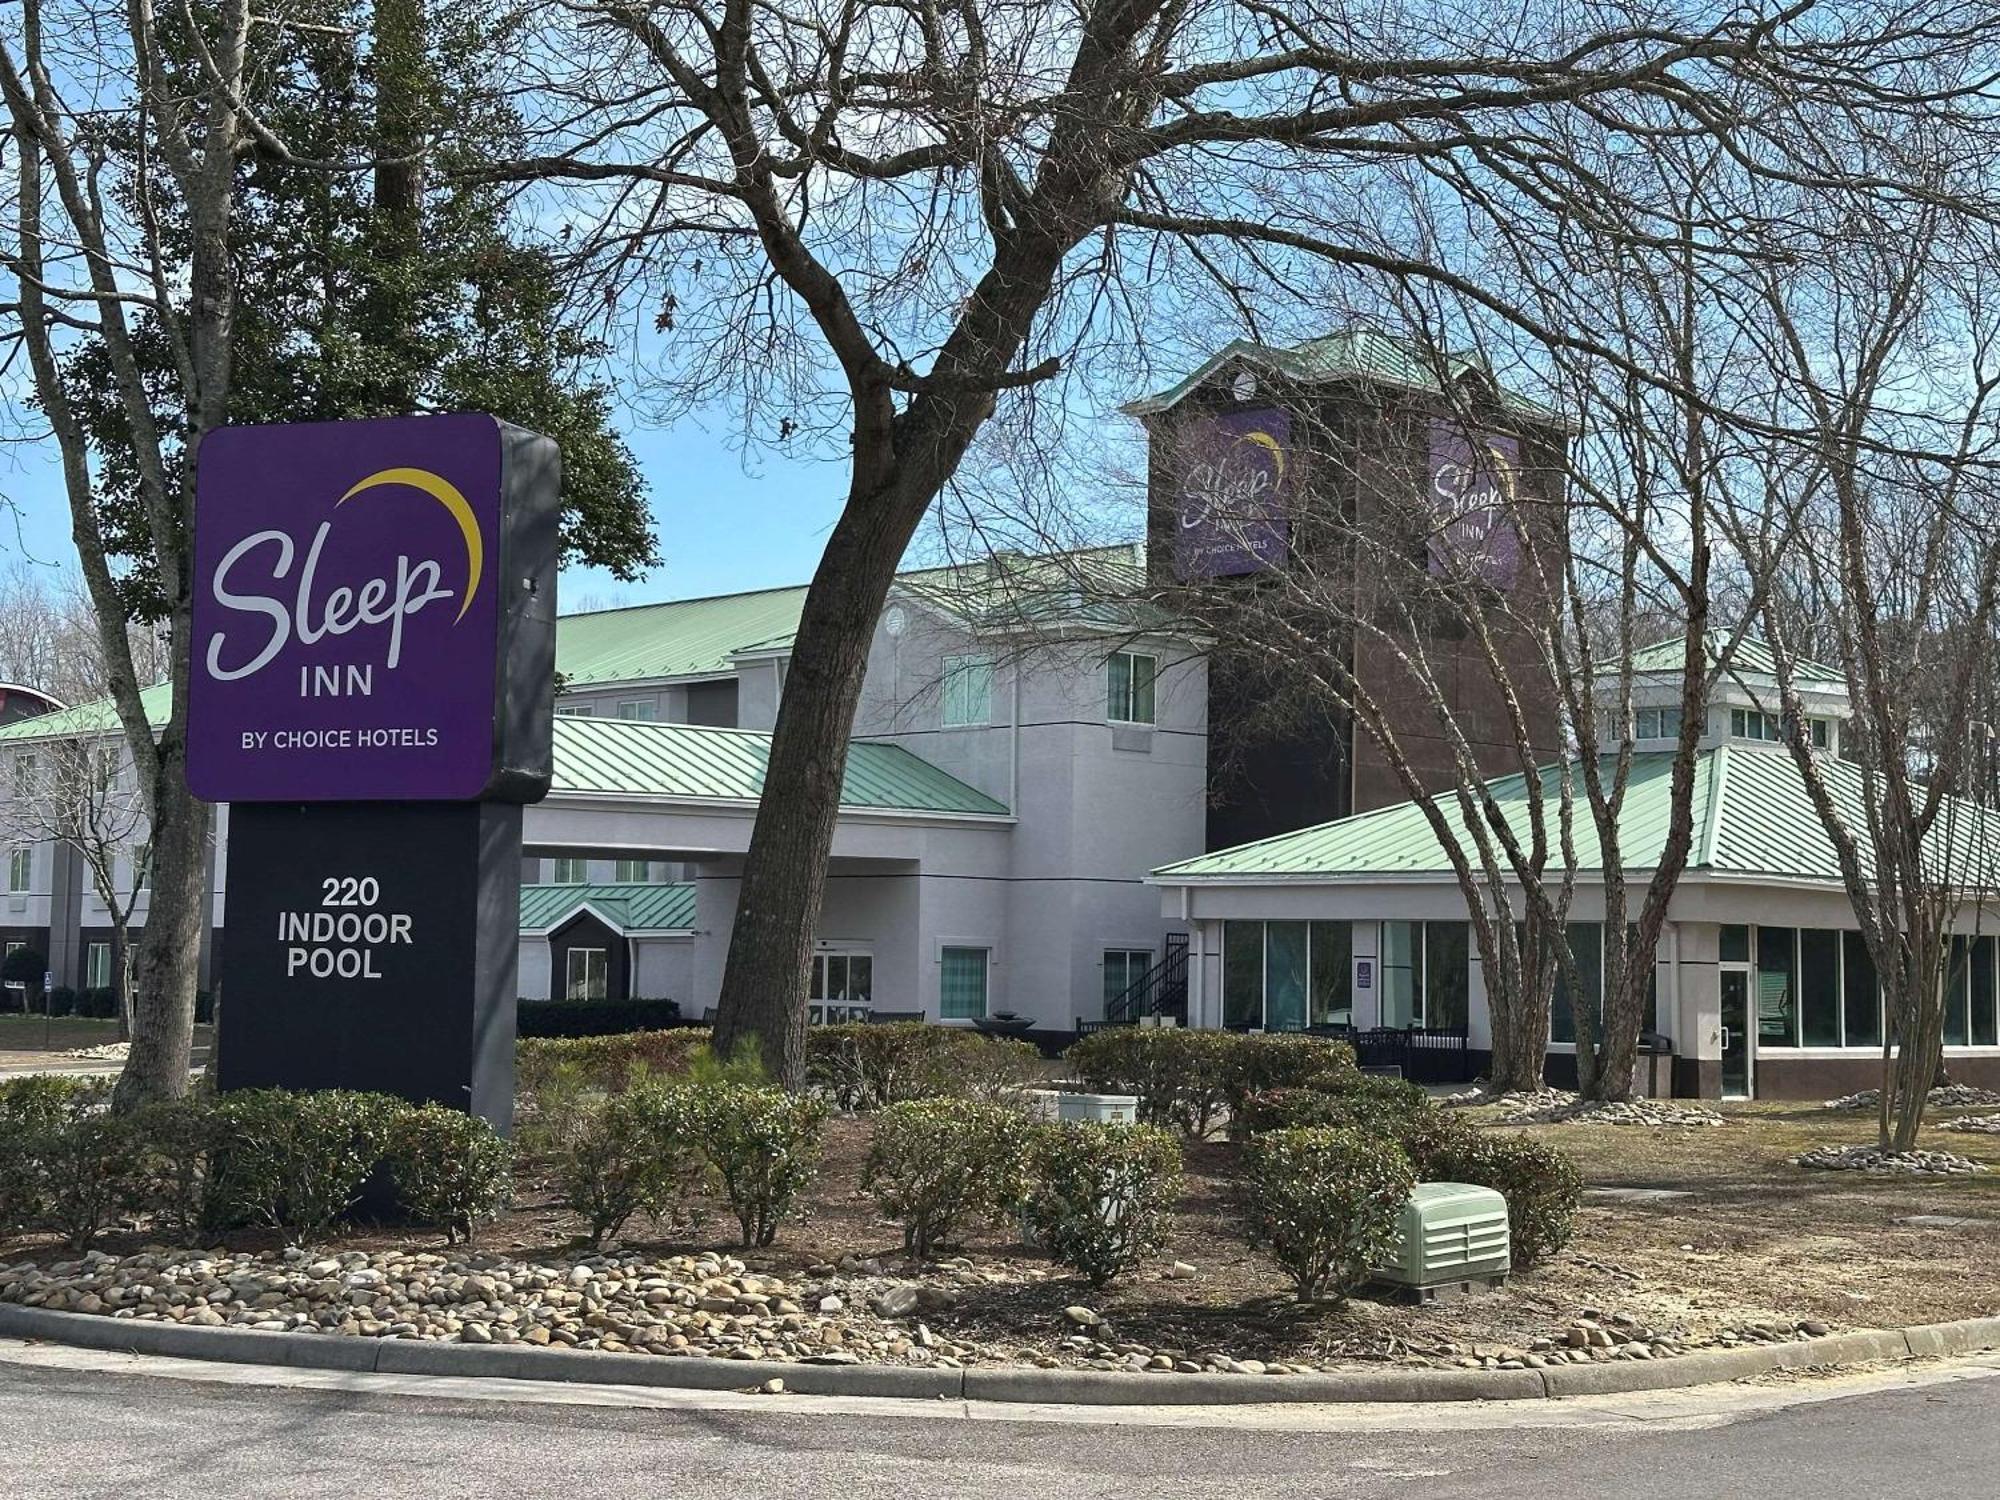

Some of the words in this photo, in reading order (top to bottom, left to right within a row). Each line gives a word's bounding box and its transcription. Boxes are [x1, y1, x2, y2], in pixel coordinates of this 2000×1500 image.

[1461, 523, 1484, 541] INN
[206, 520, 454, 681] Sleep
[300, 664, 373, 697] INN
[241, 731, 268, 749] BY
[273, 730, 351, 749] CHOICE
[358, 728, 439, 748] HOTELS
[321, 876, 380, 907] 220
[278, 911, 413, 944] INDOOR
[287, 947, 383, 979] POOL
